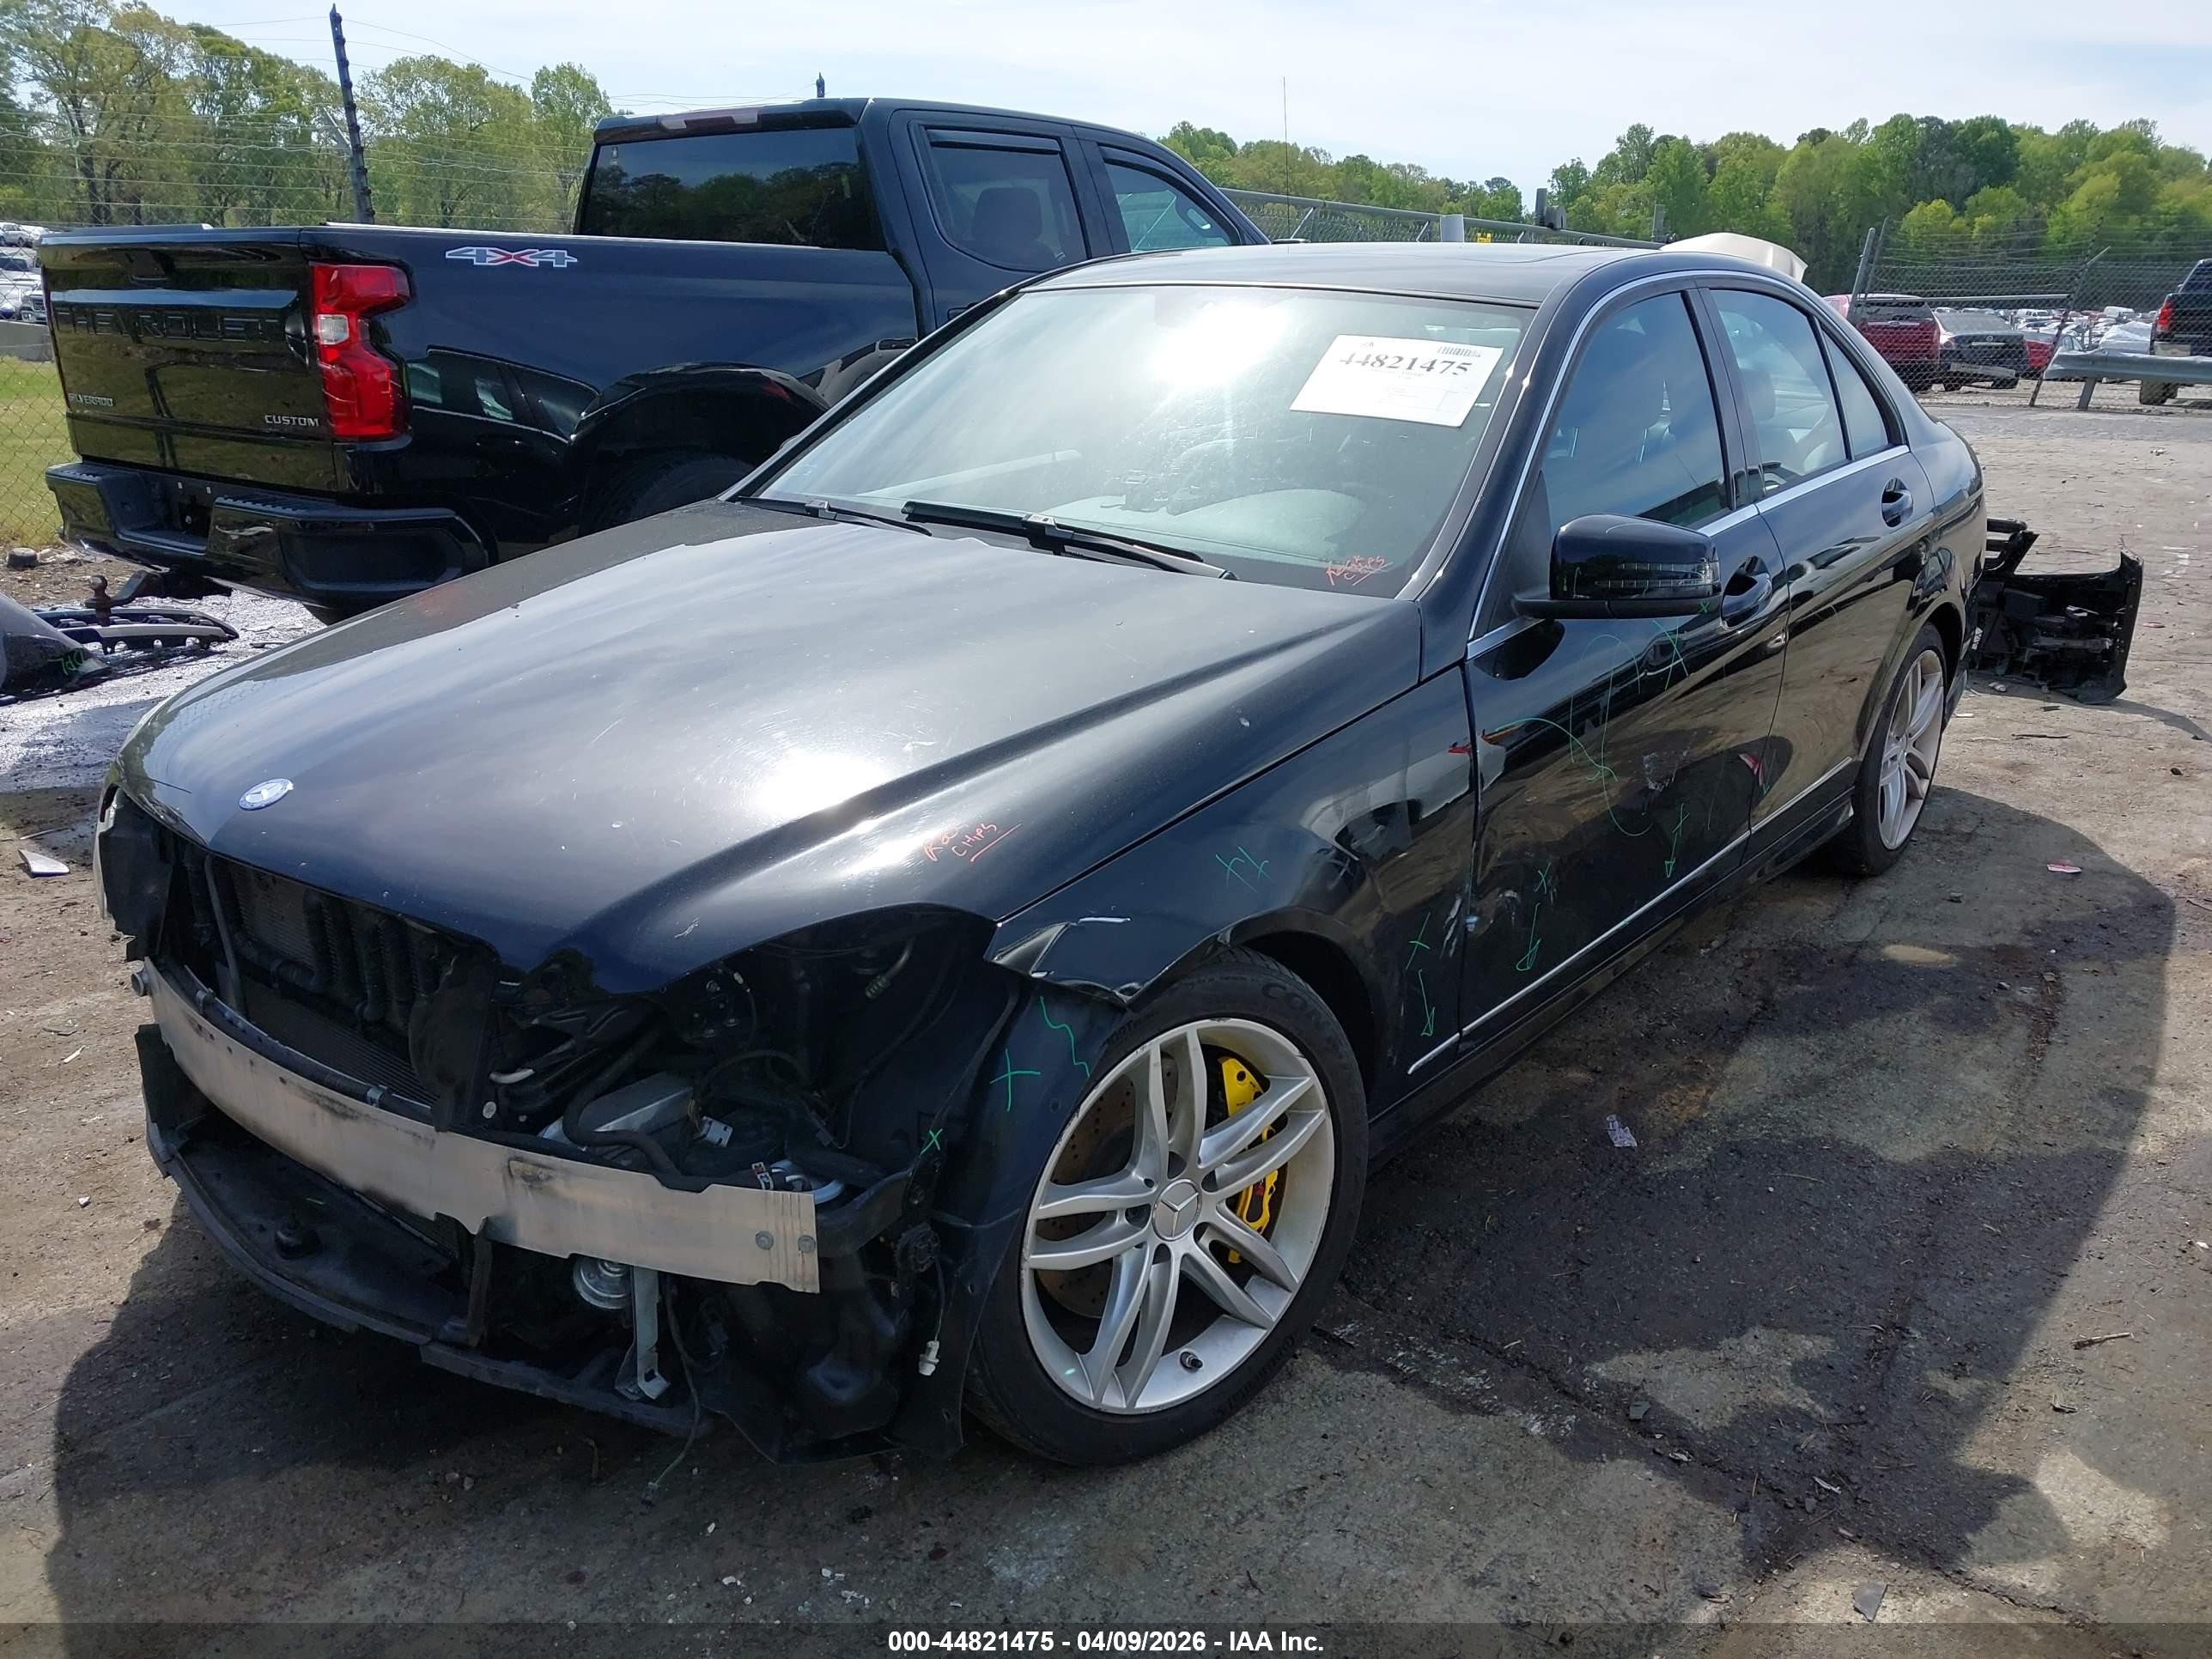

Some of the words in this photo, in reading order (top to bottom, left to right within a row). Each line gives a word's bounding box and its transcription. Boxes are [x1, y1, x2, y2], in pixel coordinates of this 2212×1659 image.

[56, 306, 281, 343] CHEVROLET
[1339, 352, 1473, 376] 44821475
[264, 415, 319, 427] CUSTOM
